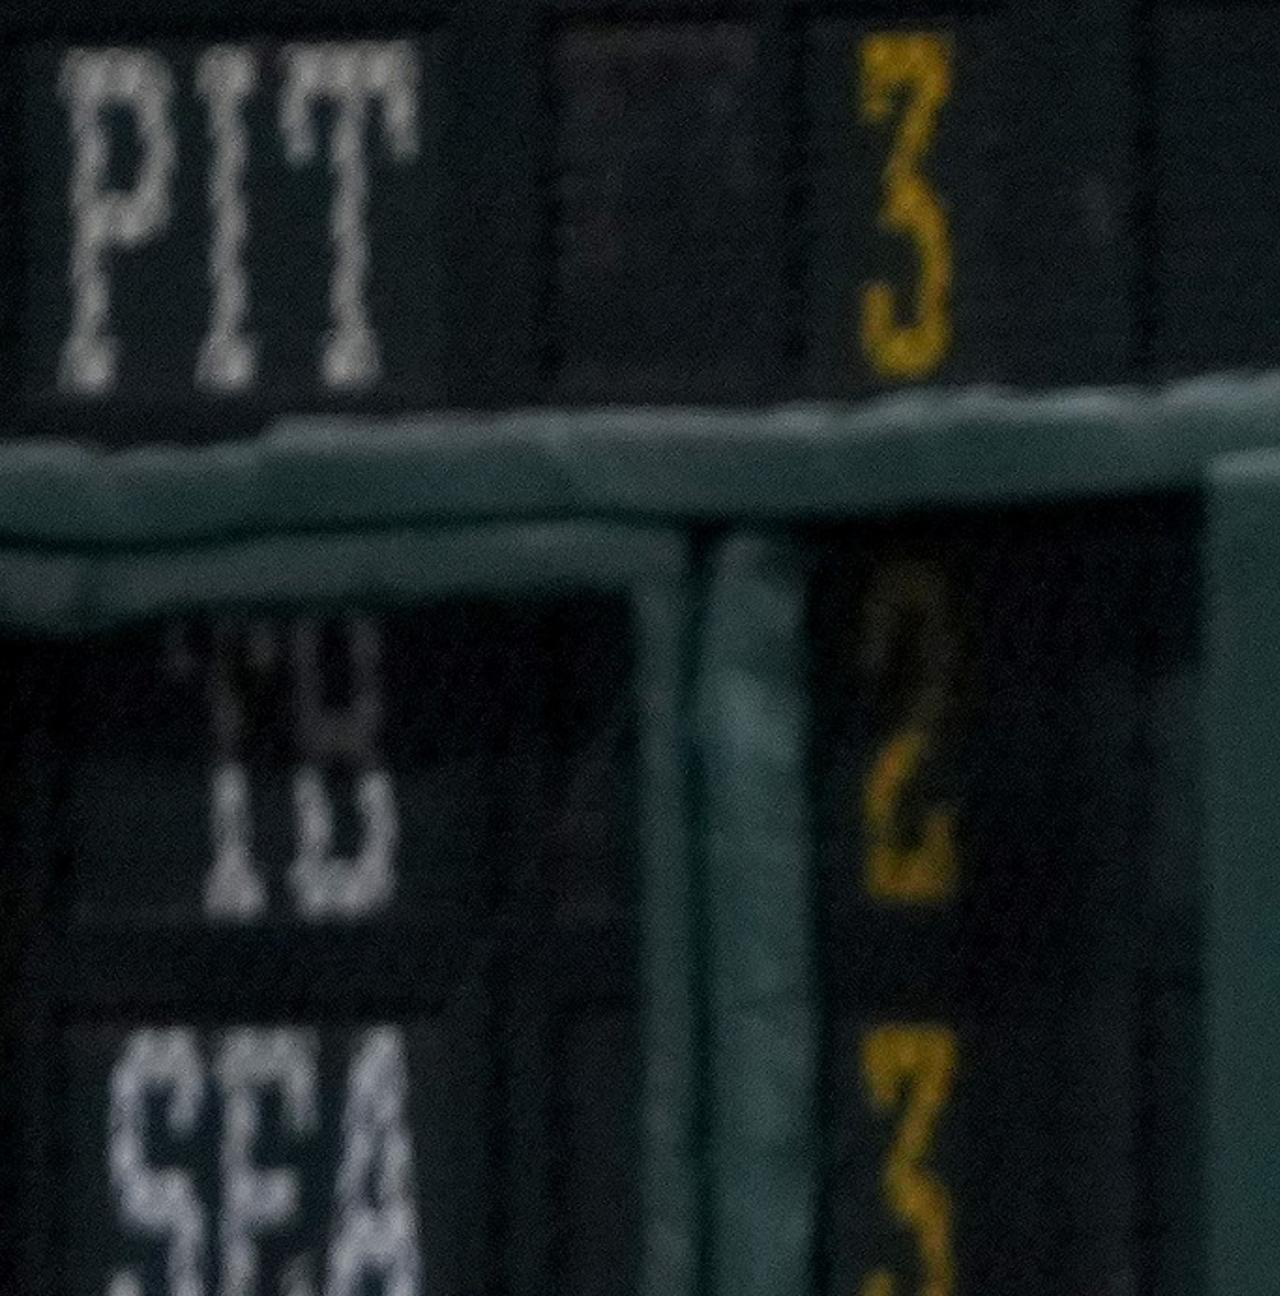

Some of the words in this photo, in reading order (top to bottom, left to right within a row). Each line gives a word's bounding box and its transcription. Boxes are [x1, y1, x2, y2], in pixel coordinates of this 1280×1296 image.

[58, 43, 420, 392] PIT
[858, 30, 955, 378] 3
[859, 560, 961, 906] 2
